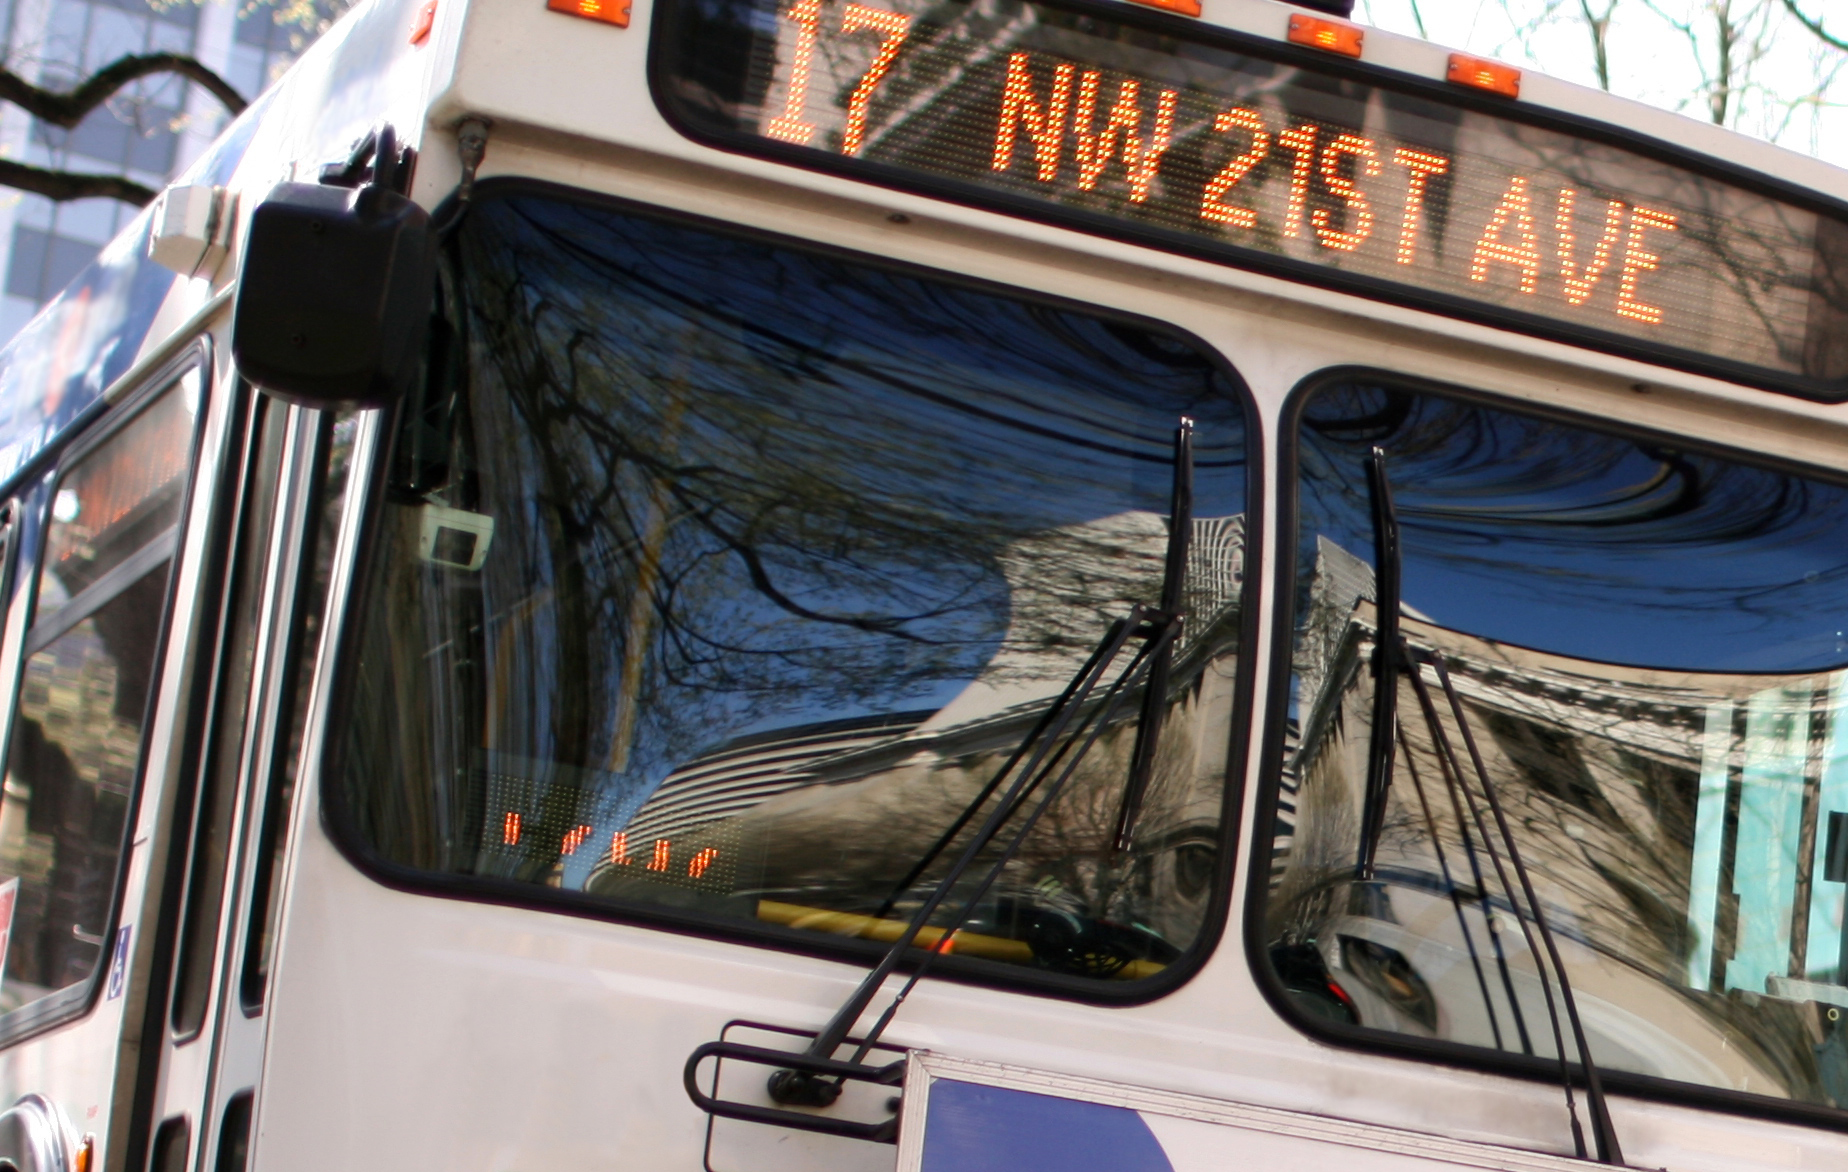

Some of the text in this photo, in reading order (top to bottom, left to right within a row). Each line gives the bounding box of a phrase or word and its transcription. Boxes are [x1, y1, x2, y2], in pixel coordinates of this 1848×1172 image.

[767, 0, 1678, 323] 17 NW 21ST AVE
